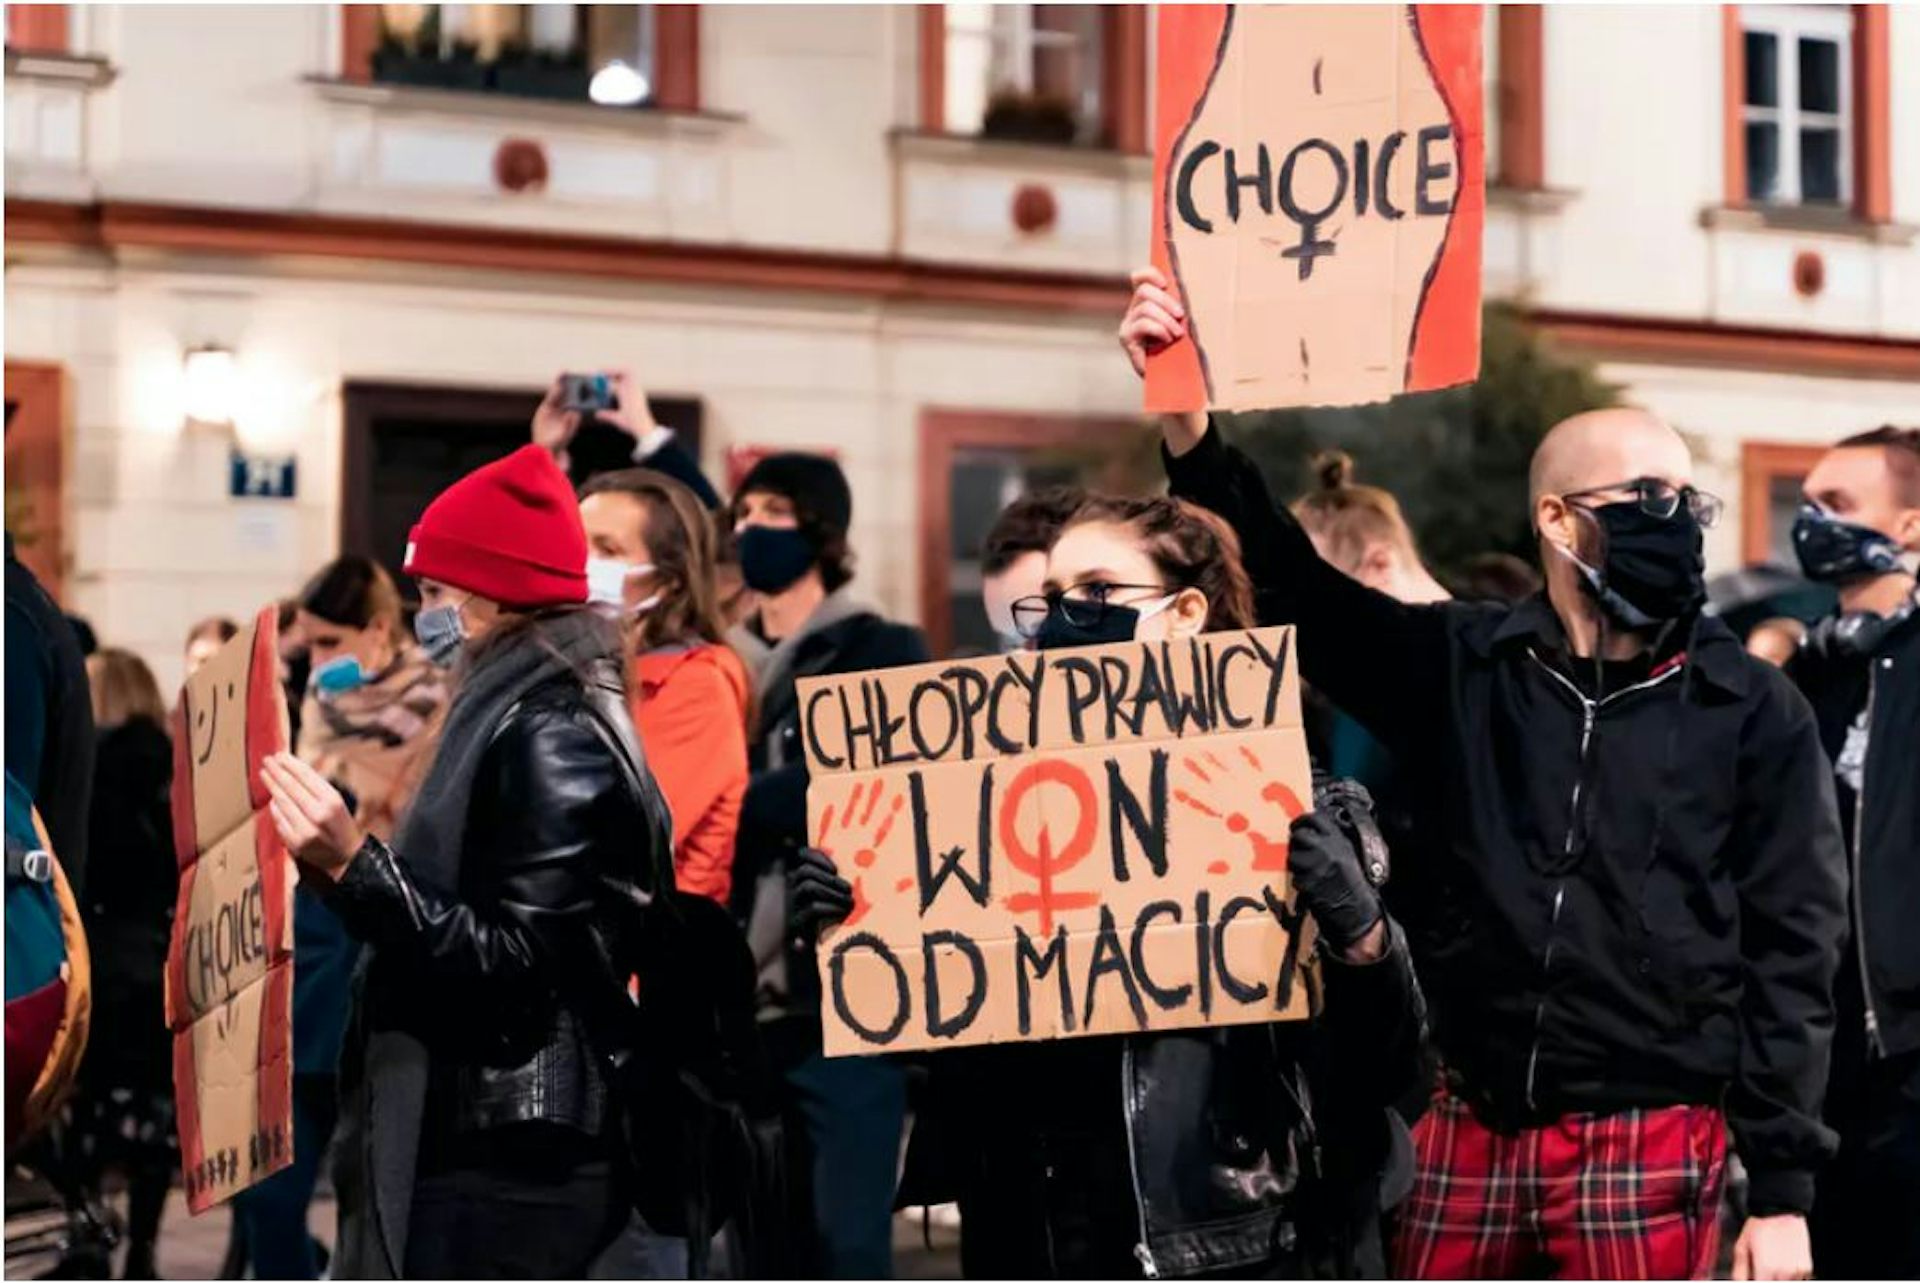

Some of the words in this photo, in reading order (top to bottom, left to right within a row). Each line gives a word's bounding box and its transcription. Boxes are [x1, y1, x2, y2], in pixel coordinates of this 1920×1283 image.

[1176, 125, 1453, 280] CHOICE
[806, 653, 1045, 769] CHŁOPCY
[1052, 628, 1291, 742] PRAWICY
[908, 749, 1170, 937] WON
[185, 881, 264, 1029] CHOICE
[829, 931, 987, 1043] OD
[1014, 885, 1303, 1034] MACICY
